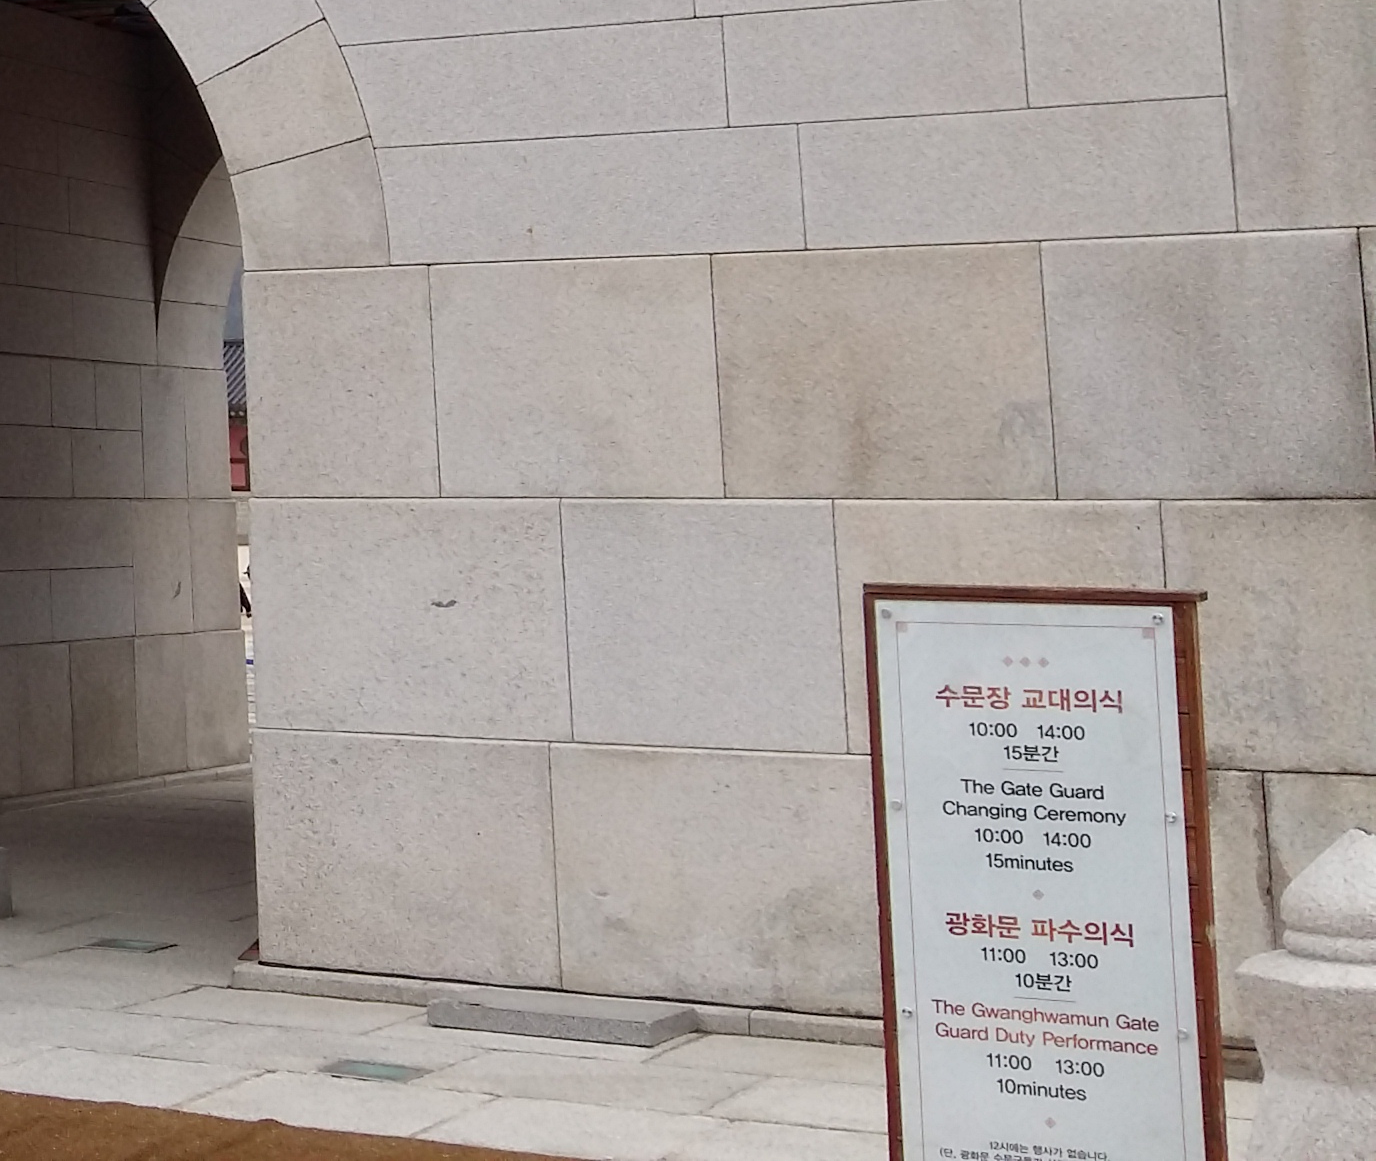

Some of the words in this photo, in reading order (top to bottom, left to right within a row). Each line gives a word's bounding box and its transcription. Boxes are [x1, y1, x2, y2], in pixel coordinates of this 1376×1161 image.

[935, 684, 1012, 710] 수문장
[1021, 687, 1123, 714] 교대의식
[968, 721, 1018, 738] 10:00
[1037, 724, 1085, 740] 14:00
[1003, 744, 1060, 763] 15분간
[960, 778, 995, 795] The
[1001, 780, 1043, 797] Gate
[1049, 783, 1105, 800] Guard
[942, 800, 1027, 821] Changing
[1033, 804, 1127, 827] Ceremony
[974, 828, 1024, 845] 10:00
[1042, 832, 1092, 848] 14:00
[985, 852, 1074, 873] 15minutes
[945, 912, 1021, 939] 광화문
[1031, 918, 1135, 948] 파수의식
[981, 947, 1027, 964] 11:00
[1049, 951, 1099, 969] 13:00
[1015, 972, 1073, 993] 10분간
[931, 999, 965, 1016] The
[971, 1002, 1109, 1028] Gwanghwamun
[1116, 1014, 1160, 1032] Gate
[935, 1022, 989, 1041] Guard
[995, 1027, 1035, 1047] Duty
[1042, 1031, 1159, 1056] Performance
[986, 1053, 1032, 1071] 11:00
[1055, 1059, 1105, 1077] 13:00
[997, 1078, 1087, 1101] 10minutes
[989, 1141, 1029, 1154] 12시에는
